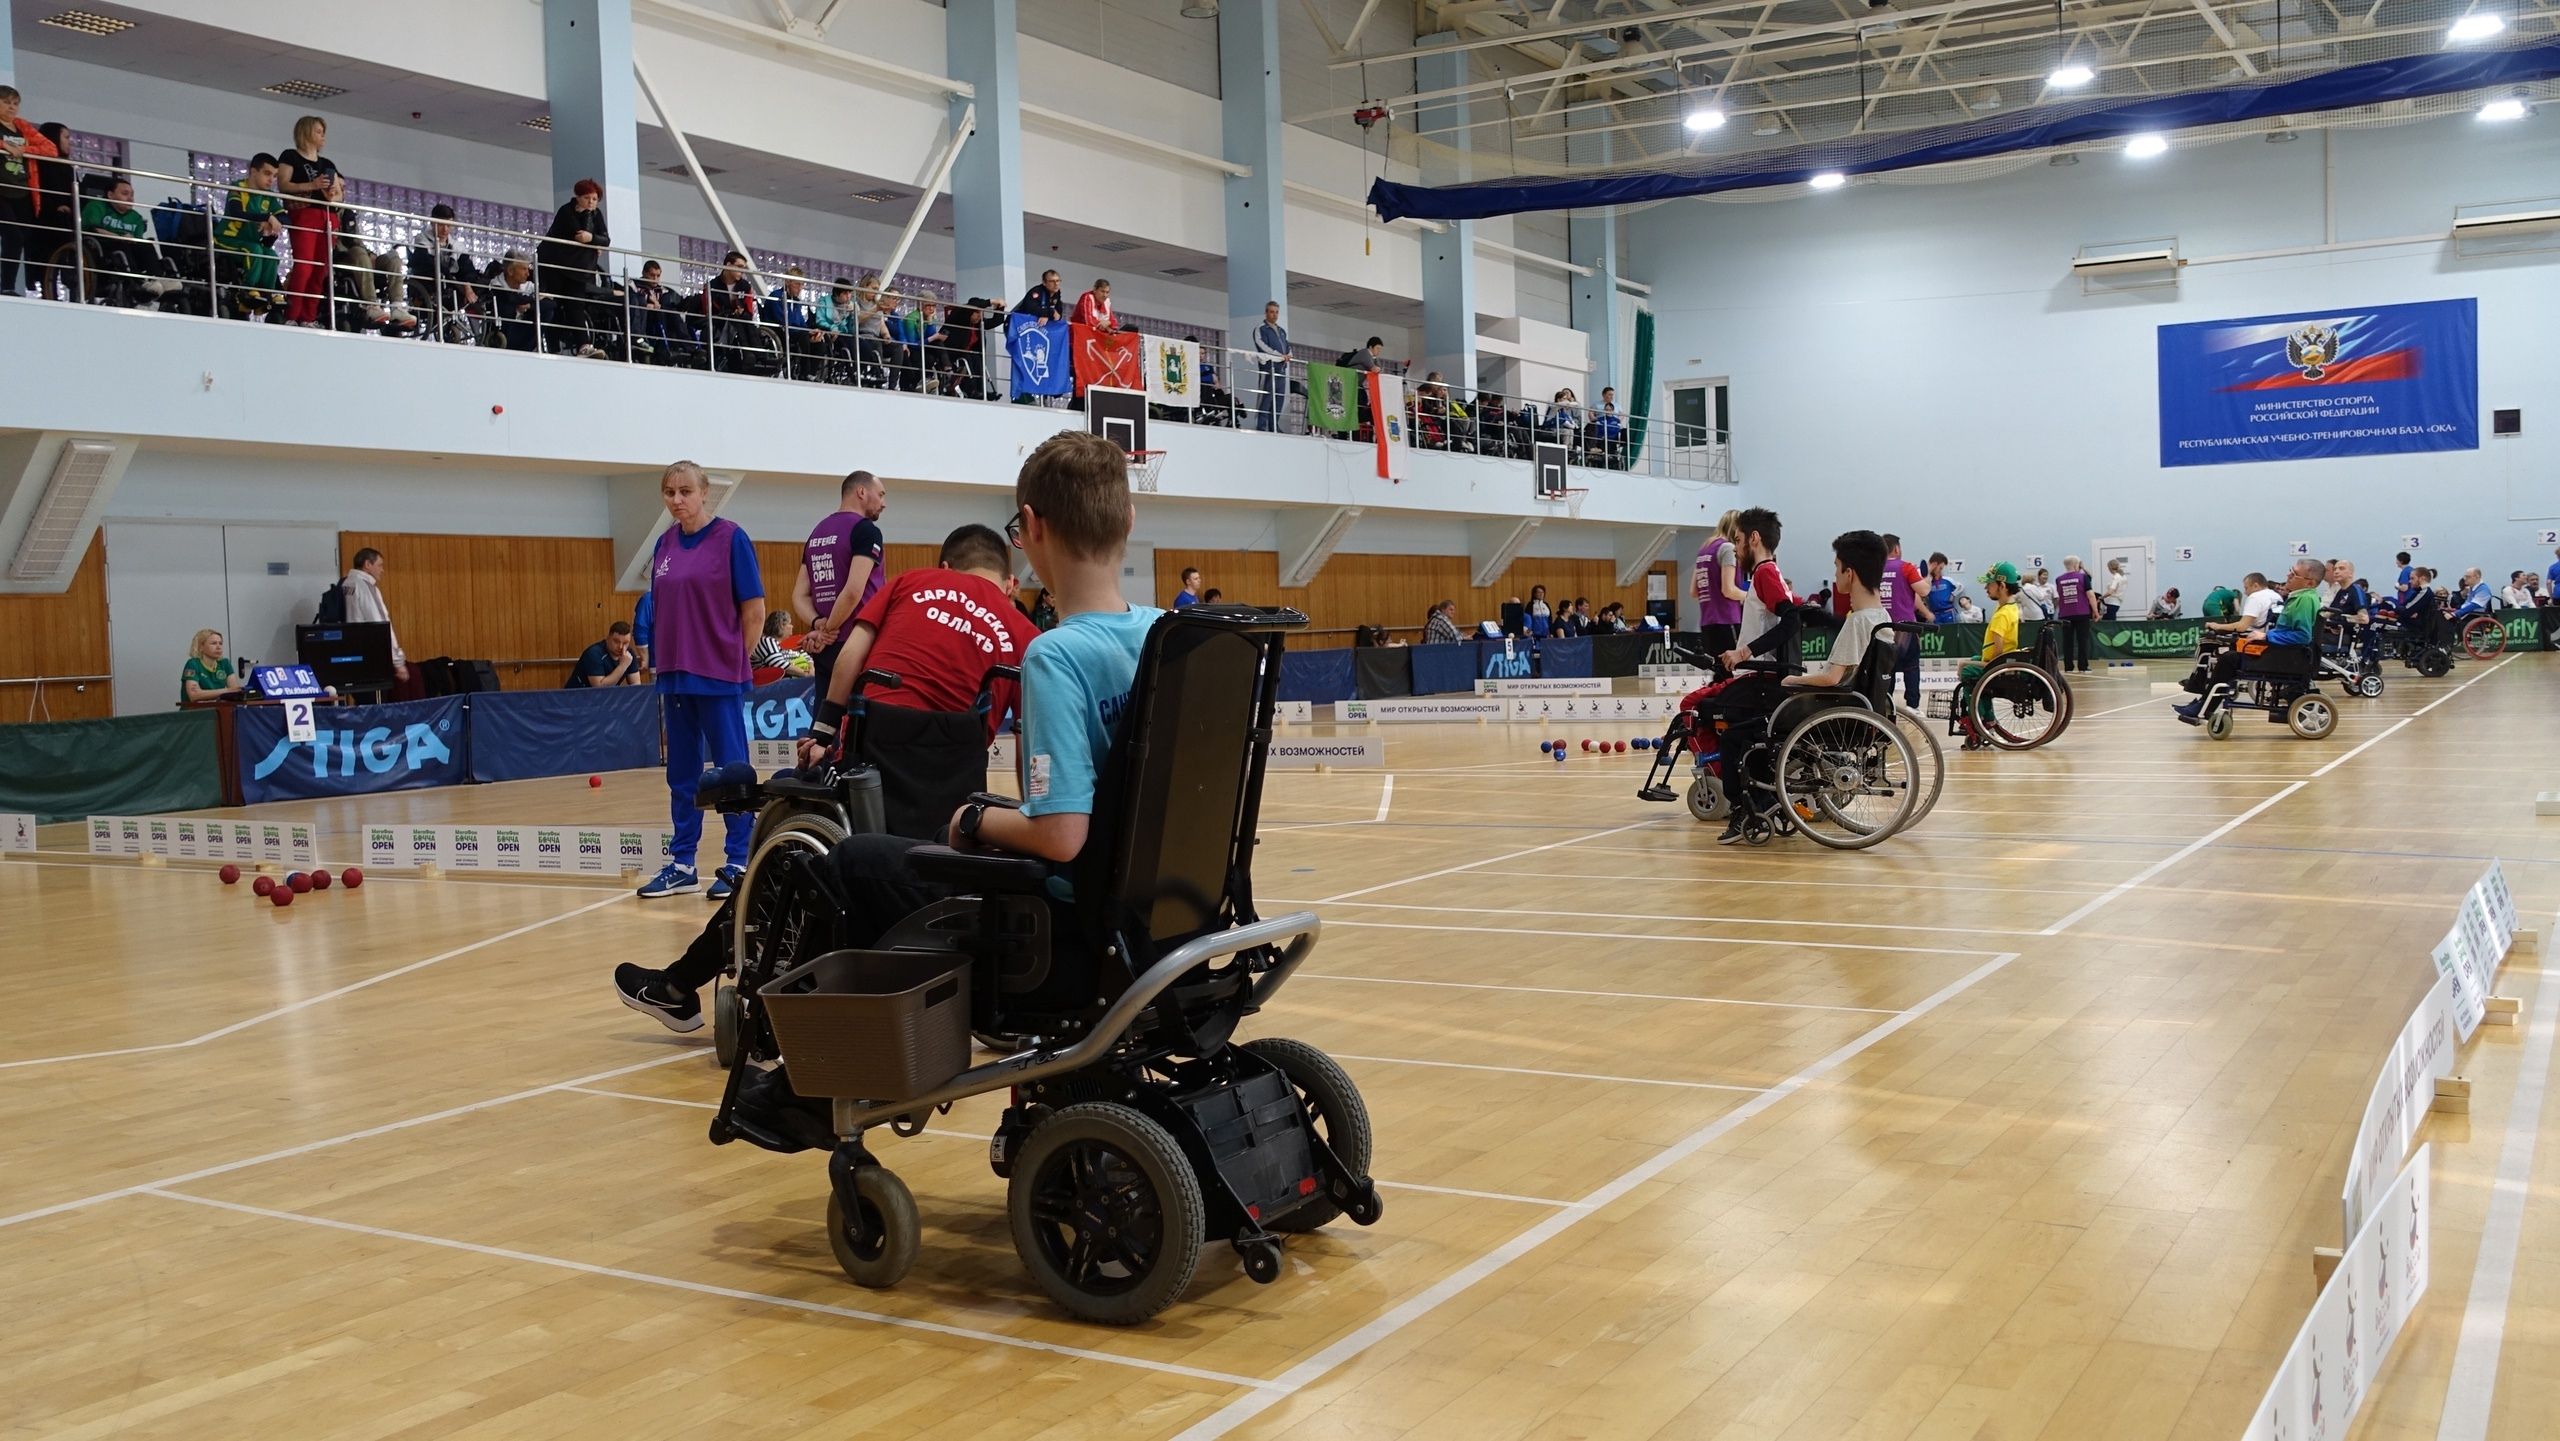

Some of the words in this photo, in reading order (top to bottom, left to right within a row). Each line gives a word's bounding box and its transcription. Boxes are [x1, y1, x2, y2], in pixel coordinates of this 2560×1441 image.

[2254, 398, 2332, 411] МИНИСТЕРСТВО
[2334, 395, 2374, 406] СПОРТА
[2250, 409, 2318, 423] РОССИЙСКОЙ
[2320, 406, 2380, 420] ФЕДЕРАЦИИ
[2179, 433, 2269, 449] РЕСПУБЛИКАНСКАЯ
[2271, 427, 2397, 443] УЧЕБНО-ТРЕНИРОВОЧНАЯ
[2399, 425, 2424, 436] БАЗА
[2546, 531, 2556, 542] 2
[2410, 537, 2419, 548] 3
[2298, 543, 2307, 553] 4
[2184, 549, 2191, 558] 5
[1955, 561, 1963, 571] 7
[2034, 557, 2042, 567] 6
[912, 589, 1014, 652] САРАТОВСКАЯ
[926, 607, 994, 653] ОБЛАТЬ
[2131, 627, 2199, 647] Butterfl
[1486, 651, 1531, 678] STIGA
[295, 669, 311, 685] 10
[1440, 705, 1500, 713] ВОЗМОЖНОСТЕЙ
[292, 704, 309, 726] 2
[743, 697, 813, 740] IGA
[254, 723, 450, 780] STIGA
[1280, 746, 1365, 756] ВОЗМОЖНОСТЕЙ
[95, 831, 110, 839] OPEN
[124, 832, 138, 840] OPEN
[180, 834, 195, 842] OPEN
[208, 835, 223, 843] OPEN
[236, 836, 251, 844] OPEN
[264, 838, 280, 846] OPEN
[293, 839, 309, 847] OPEN
[372, 842, 394, 850] OPEN
[414, 842, 436, 850] OPEN
[456, 843, 478, 851] OPEN
[497, 843, 519, 851] OPEN
[539, 844, 560, 852] OPEN
[580, 845, 601, 853] OPEN
[621, 846, 642, 854] OPEN
